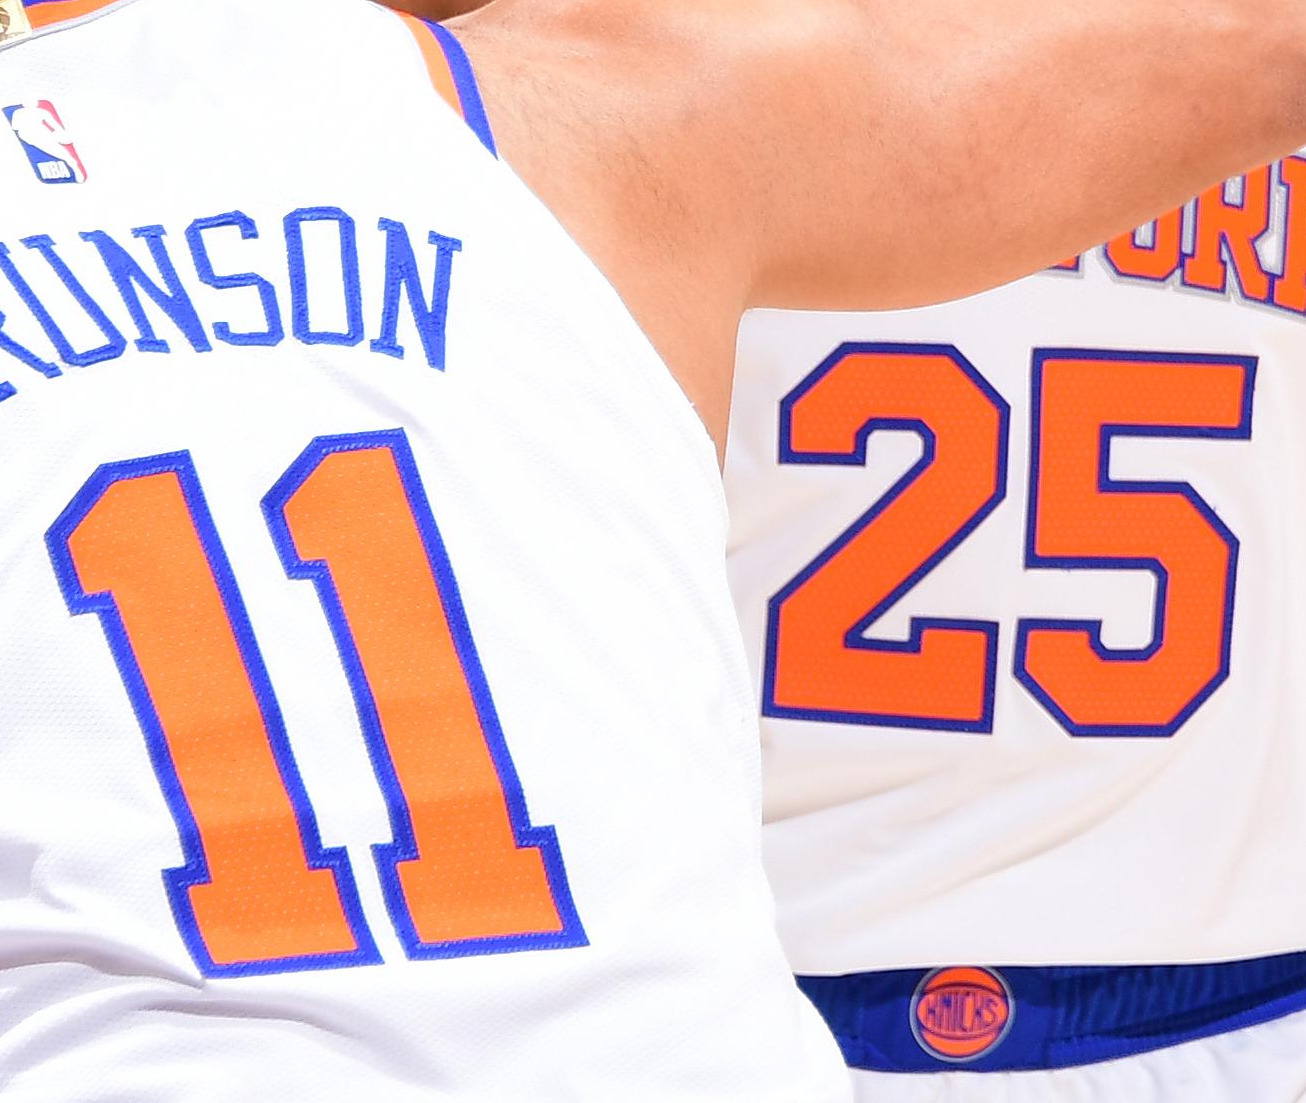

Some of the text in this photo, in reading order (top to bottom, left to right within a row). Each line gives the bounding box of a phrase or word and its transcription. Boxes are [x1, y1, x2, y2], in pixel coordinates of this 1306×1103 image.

[44, 427, 591, 980] 11
[762, 341, 1259, 738] 25
[924, 990, 1000, 1033] KNICKS
